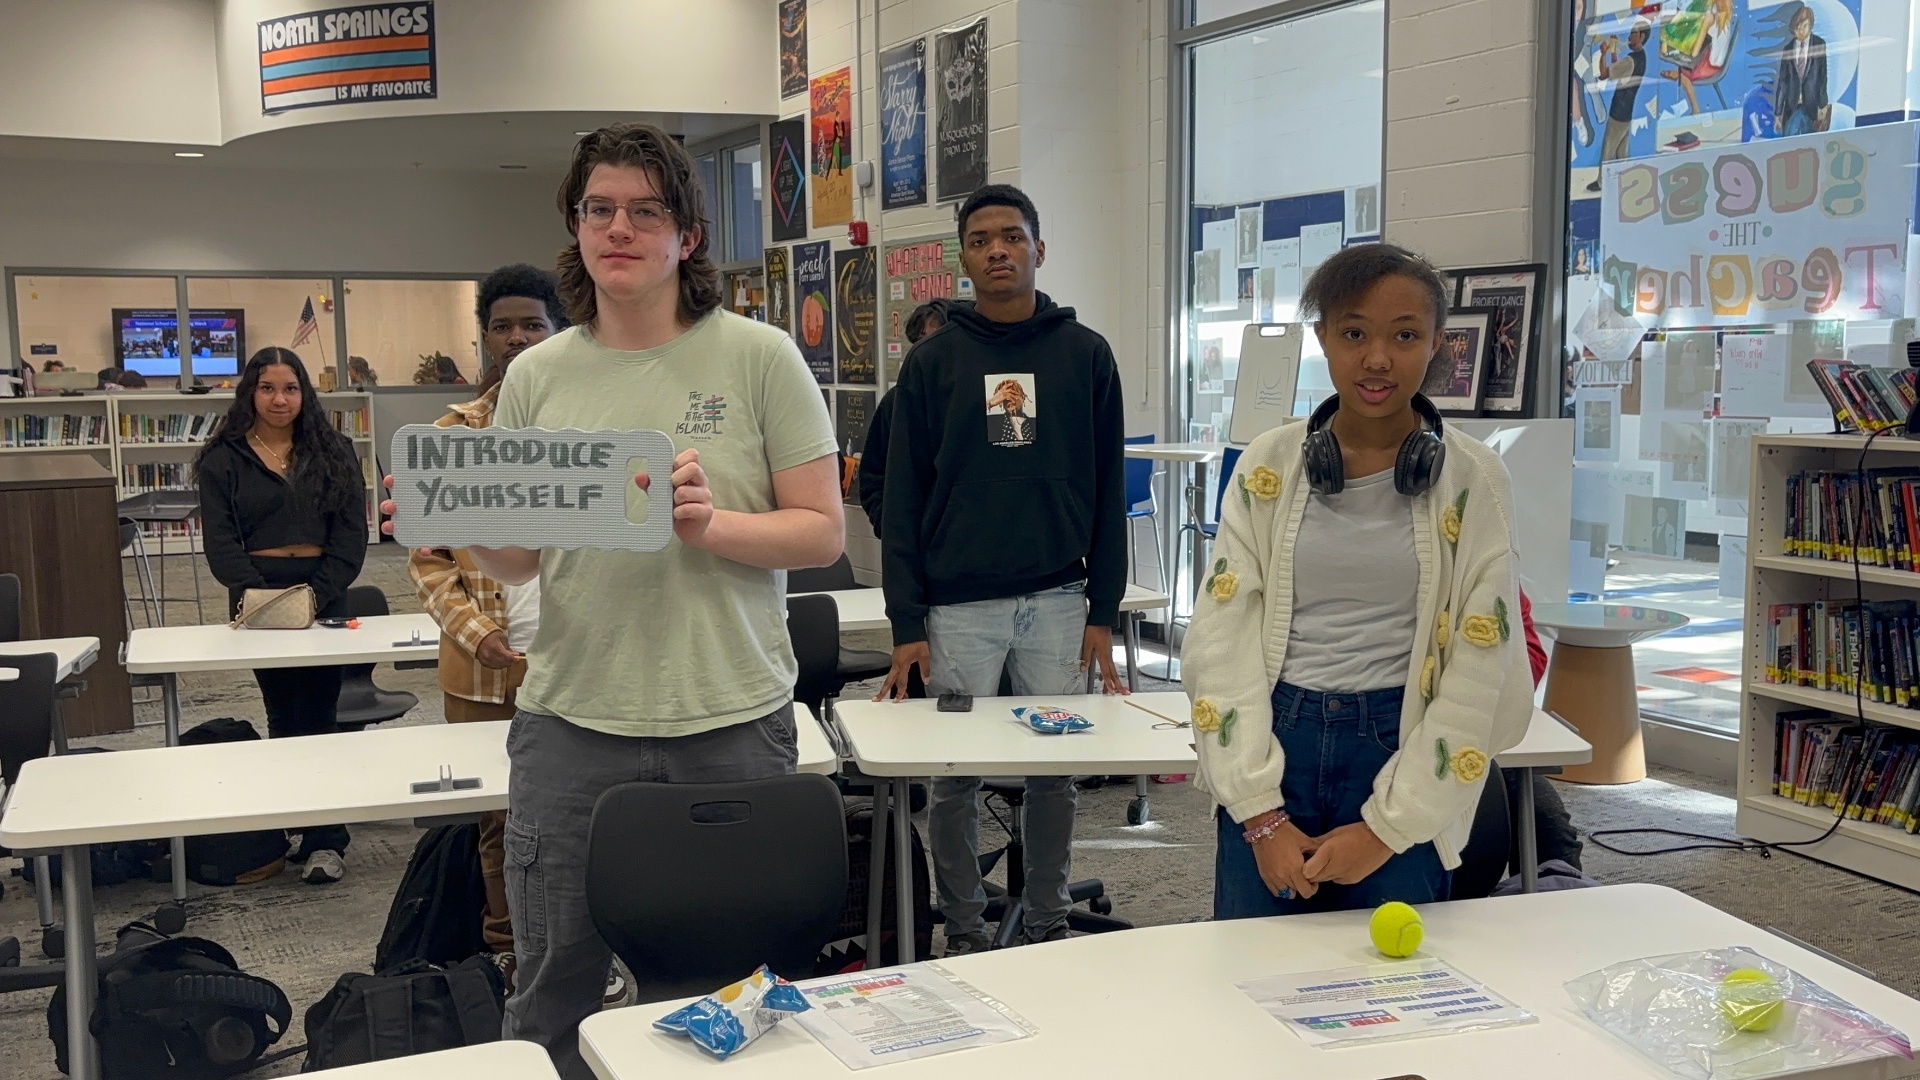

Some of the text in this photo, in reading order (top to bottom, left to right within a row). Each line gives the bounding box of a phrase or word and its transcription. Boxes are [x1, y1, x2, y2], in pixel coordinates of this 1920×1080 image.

[261, 6, 429, 51] NORTH SPRINGS
[337, 80, 431, 99] IS MY FAVORITE
[881, 73, 918, 118] Starry
[881, 103, 925, 155] Night
[797, 246, 828, 286] peach
[886, 242, 944, 278] WHATCHA
[911, 272, 952, 301] WANNA
[1472, 295, 1525, 307] PROJECT DANCE
[689, 391, 703, 401] TAKE
[675, 422, 711, 434] ISLAND
[685, 411, 704, 422] TO THE
[407, 434, 616, 470] INTRODUCE
[415, 476, 603, 517] YOURSELF
